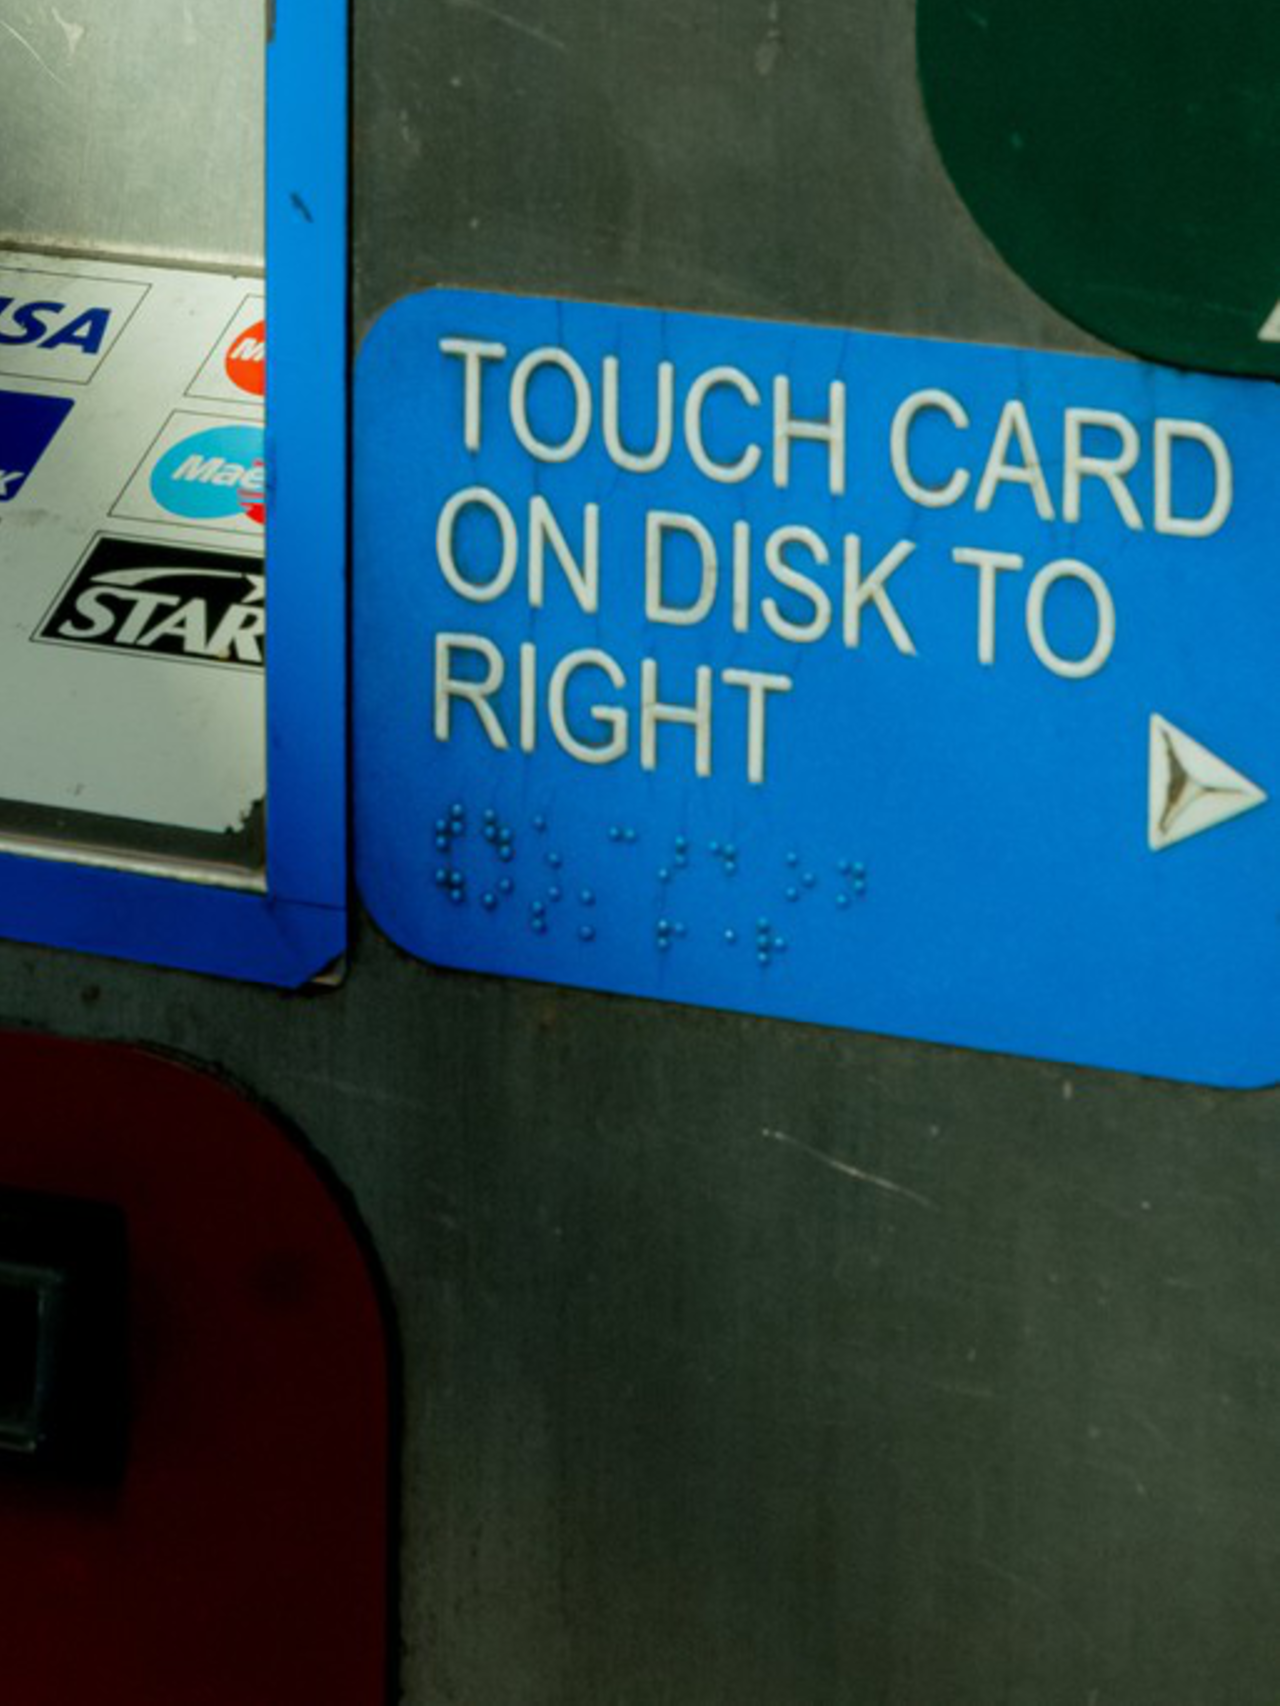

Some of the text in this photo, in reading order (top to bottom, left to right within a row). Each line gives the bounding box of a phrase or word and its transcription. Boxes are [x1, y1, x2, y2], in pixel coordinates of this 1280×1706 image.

[439, 337, 1235, 538] TOUCH CARD
[57, 587, 266, 665] STAR
[437, 486, 1116, 680] ON DISK TO
[435, 631, 793, 785] RIGHT
